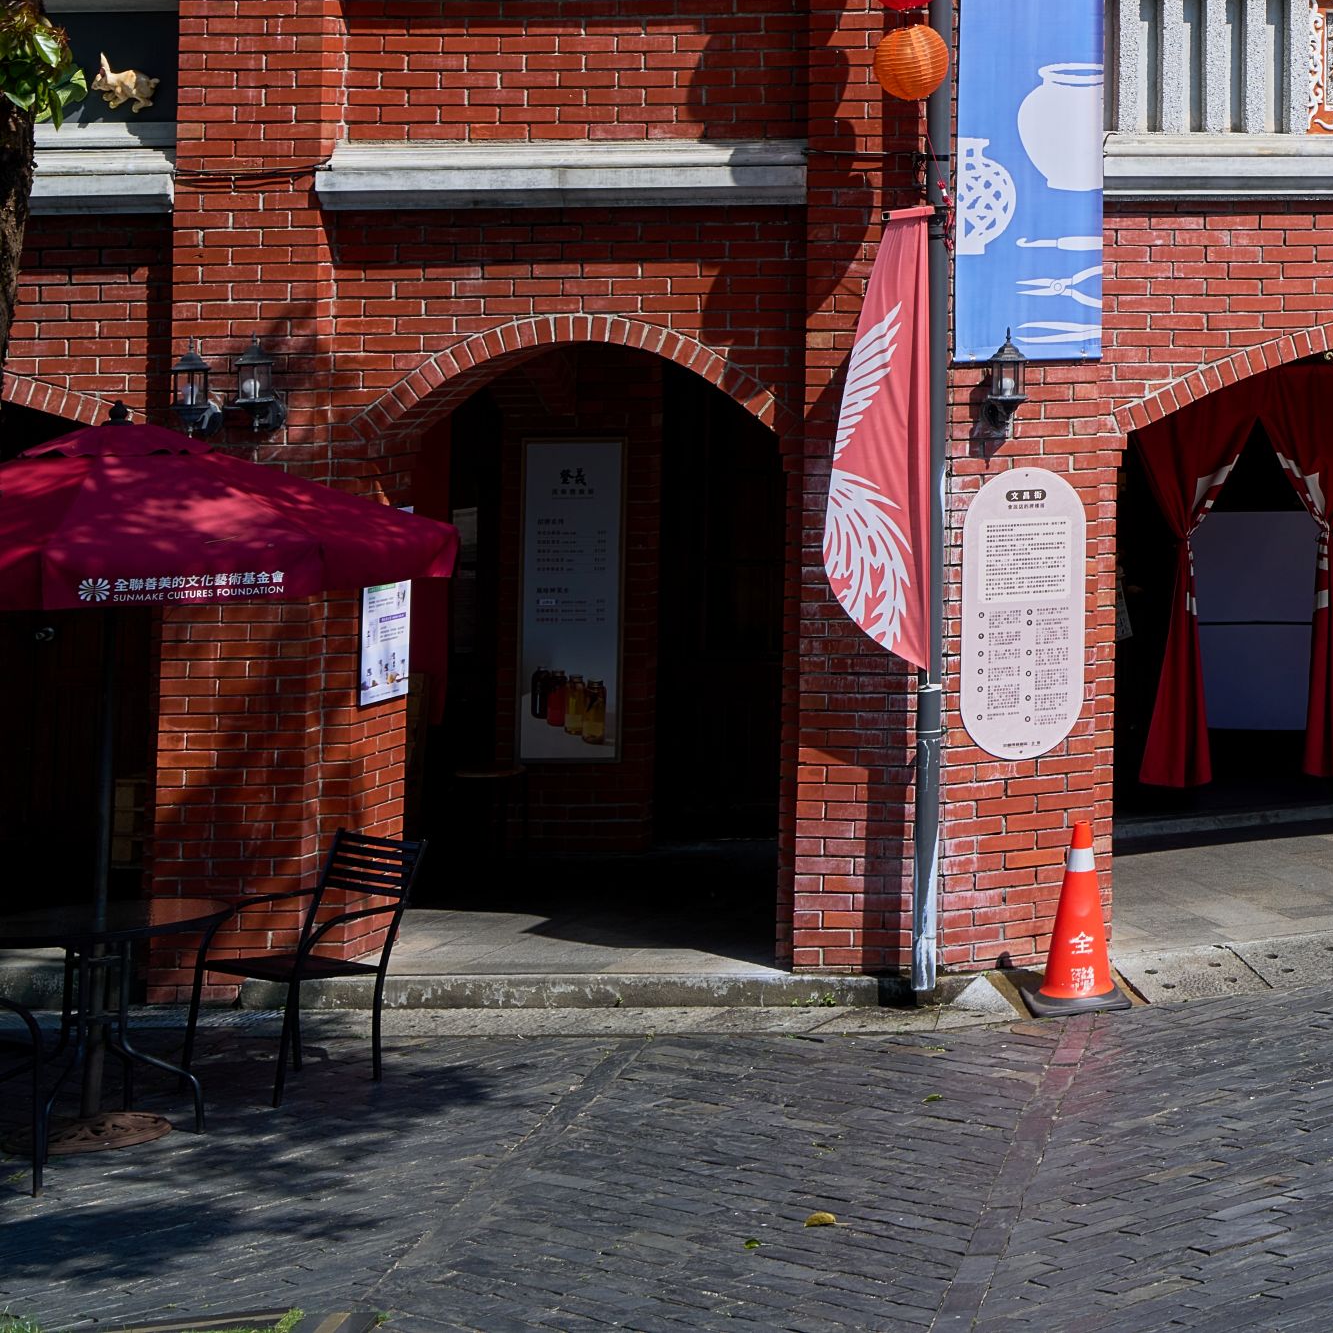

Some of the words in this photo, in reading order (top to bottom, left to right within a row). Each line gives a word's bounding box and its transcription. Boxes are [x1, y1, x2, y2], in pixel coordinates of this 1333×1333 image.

[1010, 490, 1043, 501] 文昌街
[113, 570, 286, 593] 全聯善美的文化藝術基金會
[112, 592, 165, 602] SUNMAKE
[167, 590, 214, 600] CULTURES
[216, 585, 285, 597] FOUNDATION
